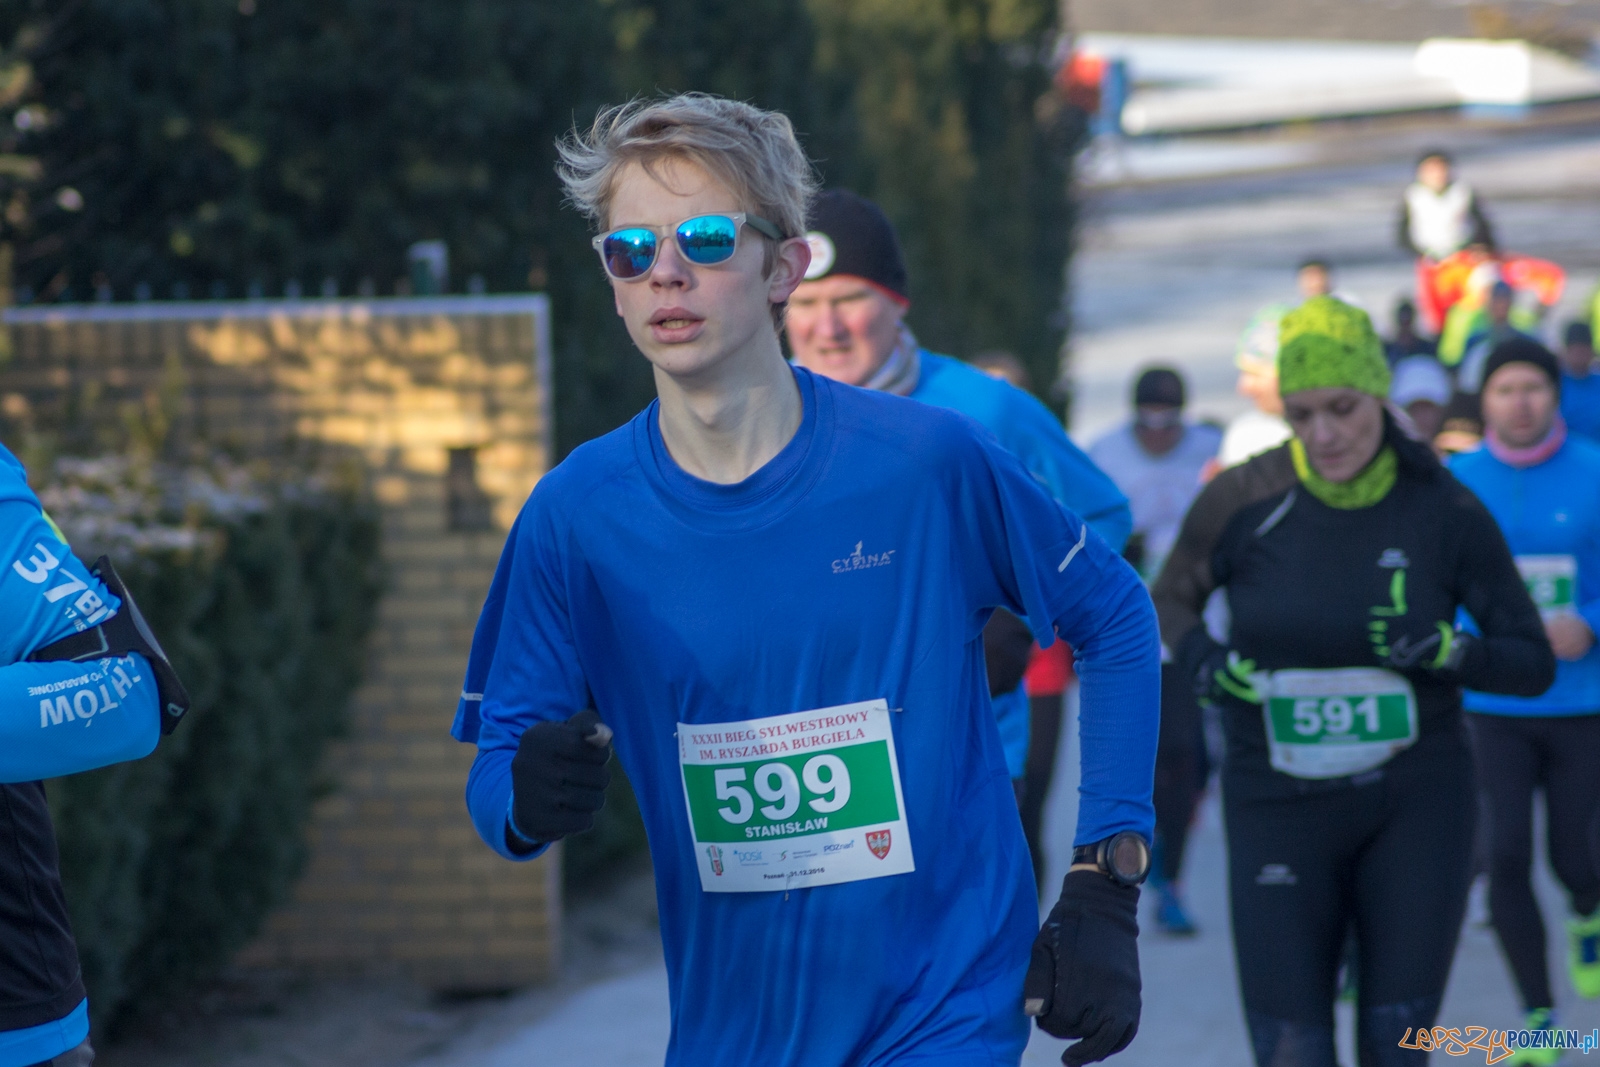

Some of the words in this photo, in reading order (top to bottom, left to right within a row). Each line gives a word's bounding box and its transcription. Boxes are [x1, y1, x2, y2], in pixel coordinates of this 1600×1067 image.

[12, 542, 89, 604] 37
[64, 607, 78, 619] 17
[691, 734, 723, 745] XXXII
[725, 729, 756, 743] BIEG
[759, 710, 870, 739] SYLWESTROWY
[1293, 696, 1380, 736] 591
[699, 749, 717, 760] IM.
[719, 741, 789, 760] RYSZARDA
[792, 727, 866, 750] BURGIELA
[714, 754, 851, 824] 599
[745, 817, 828, 839] STANISŁAW
[789, 866, 826, 879] 31.12.2016
